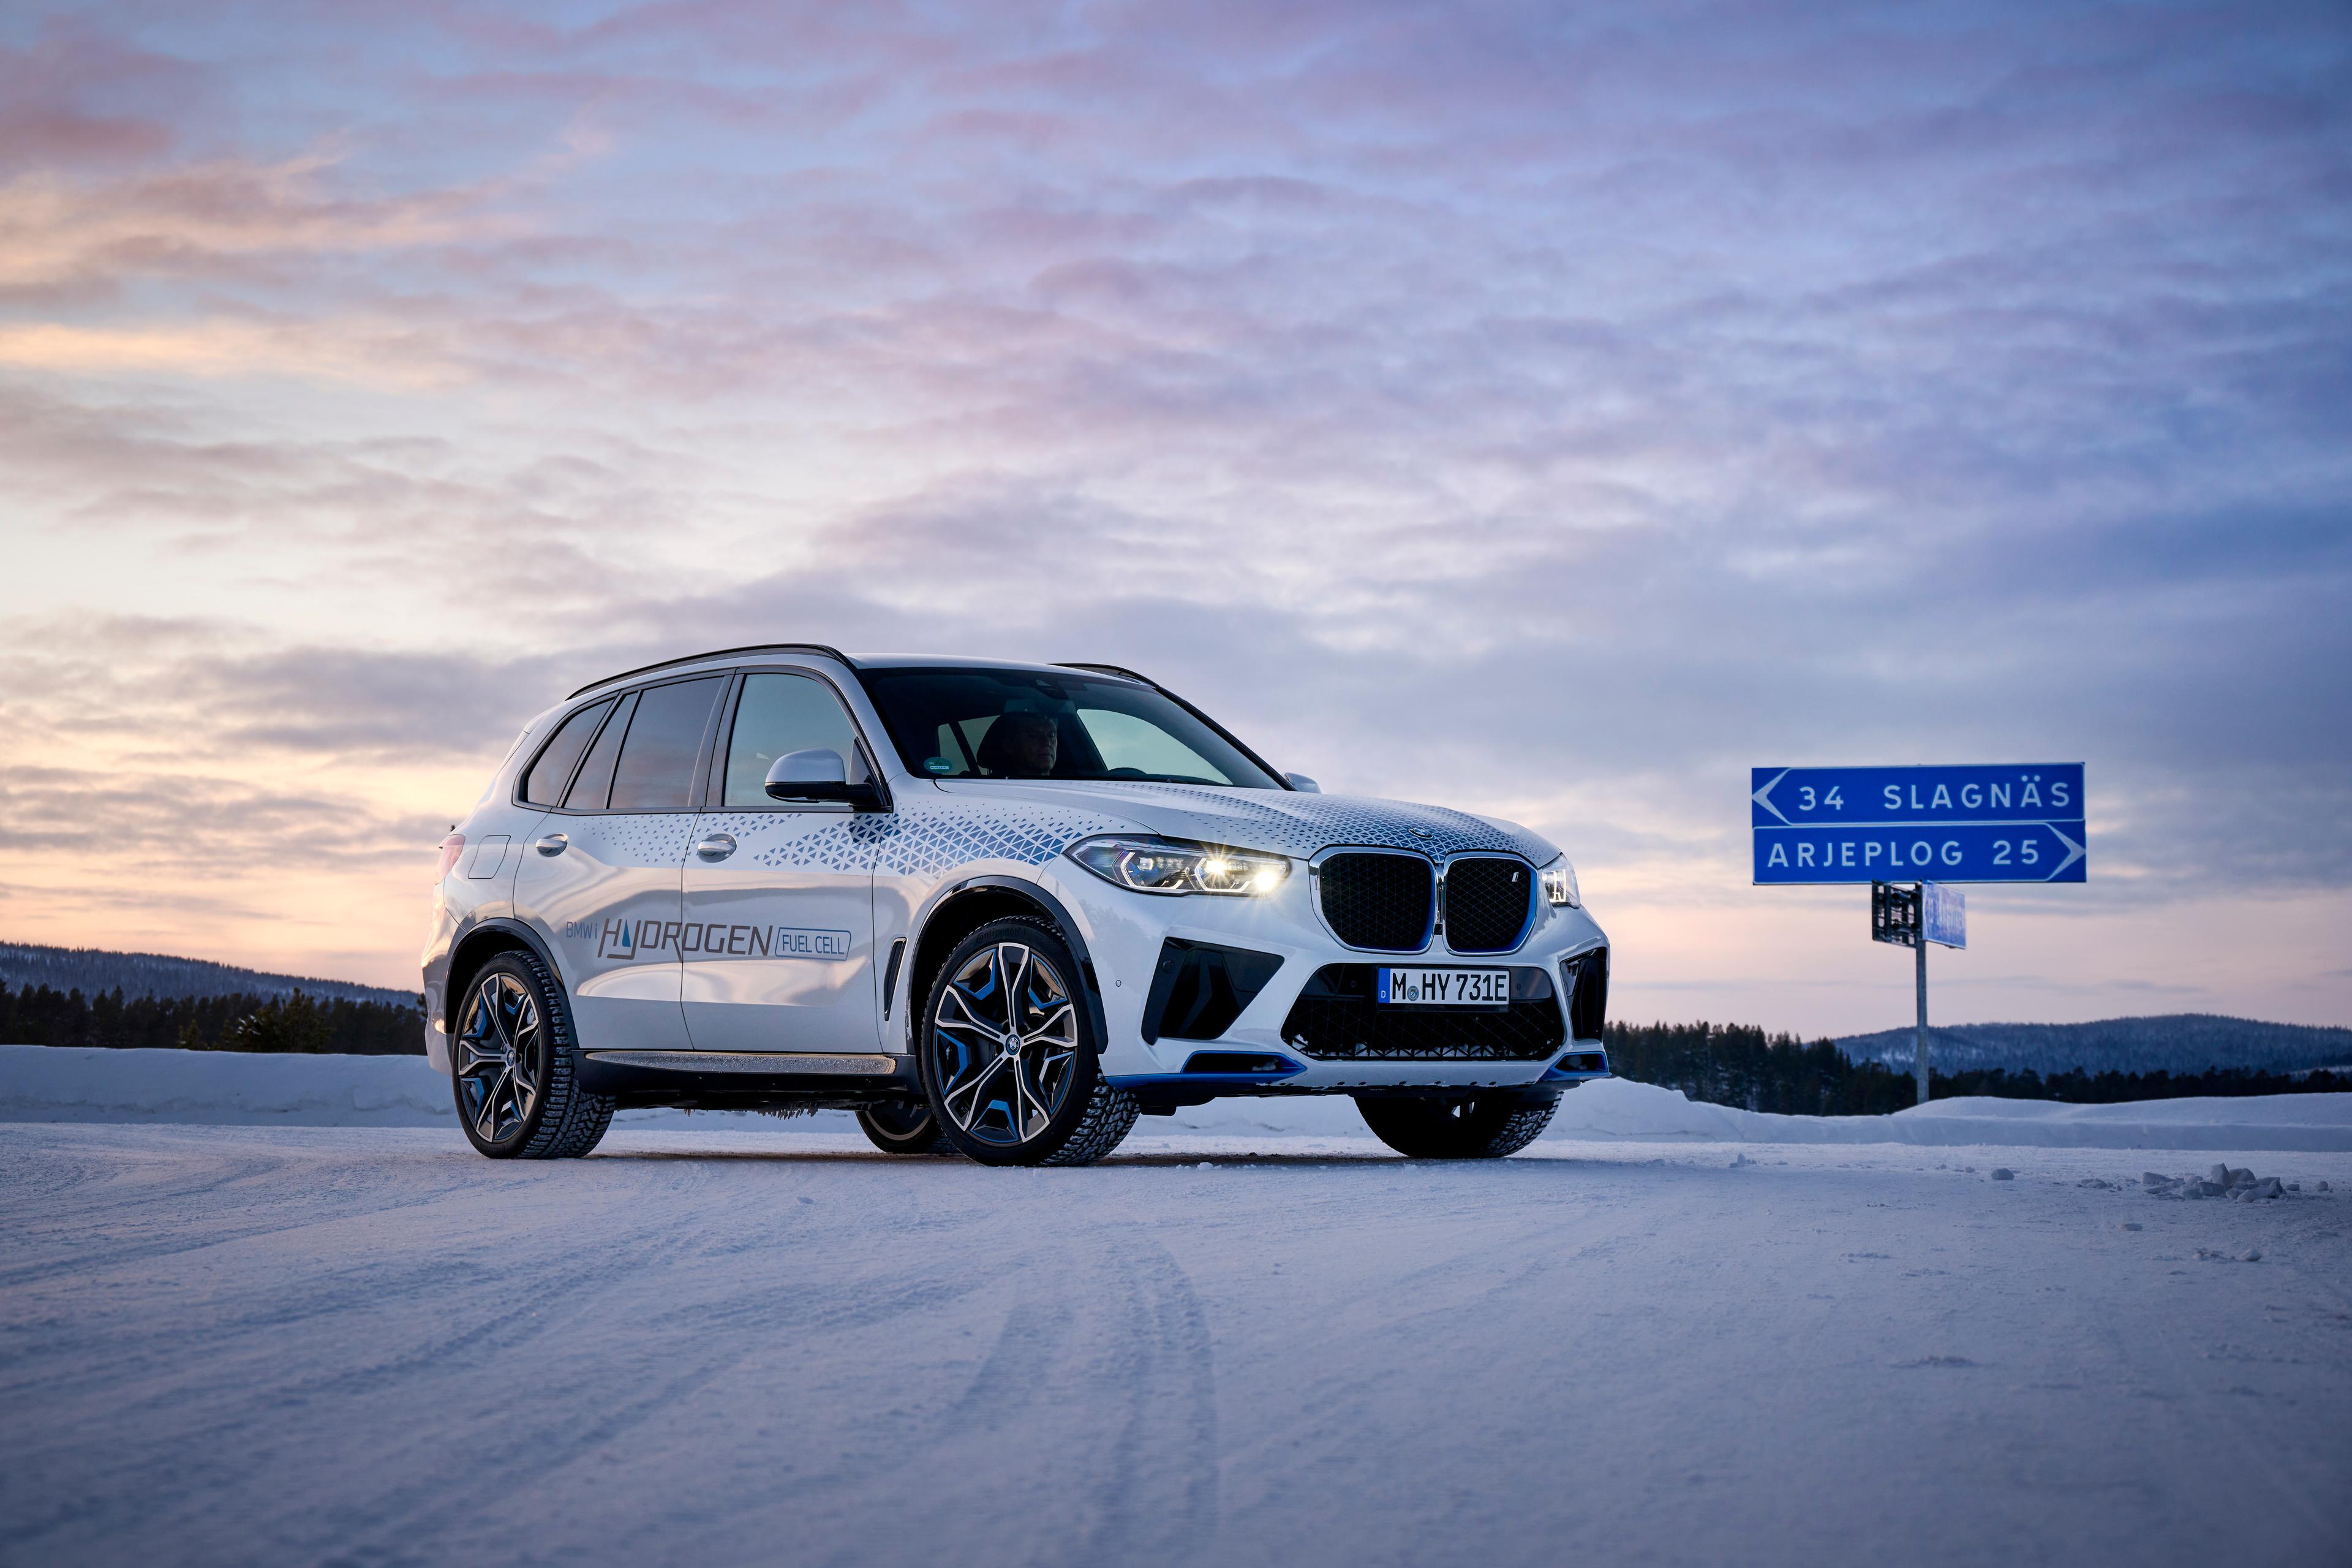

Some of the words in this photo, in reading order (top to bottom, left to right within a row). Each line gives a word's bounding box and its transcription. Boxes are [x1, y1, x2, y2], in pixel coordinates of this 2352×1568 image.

[1798, 786, 1844, 811] 34
[1883, 775, 2070, 809] SLAGNÄS
[1768, 841, 1962, 867] ARJEPLOG
[1992, 840, 2040, 865] 25
[566, 921, 592, 940] BMW
[597, 918, 773, 962] HYDROGEN
[782, 934, 813, 953] FUEL
[815, 936, 845, 955] CELL
[1392, 973, 1406, 1000] M
[1422, 973, 1450, 1000] HY
[1456, 974, 1507, 1001] 731E
